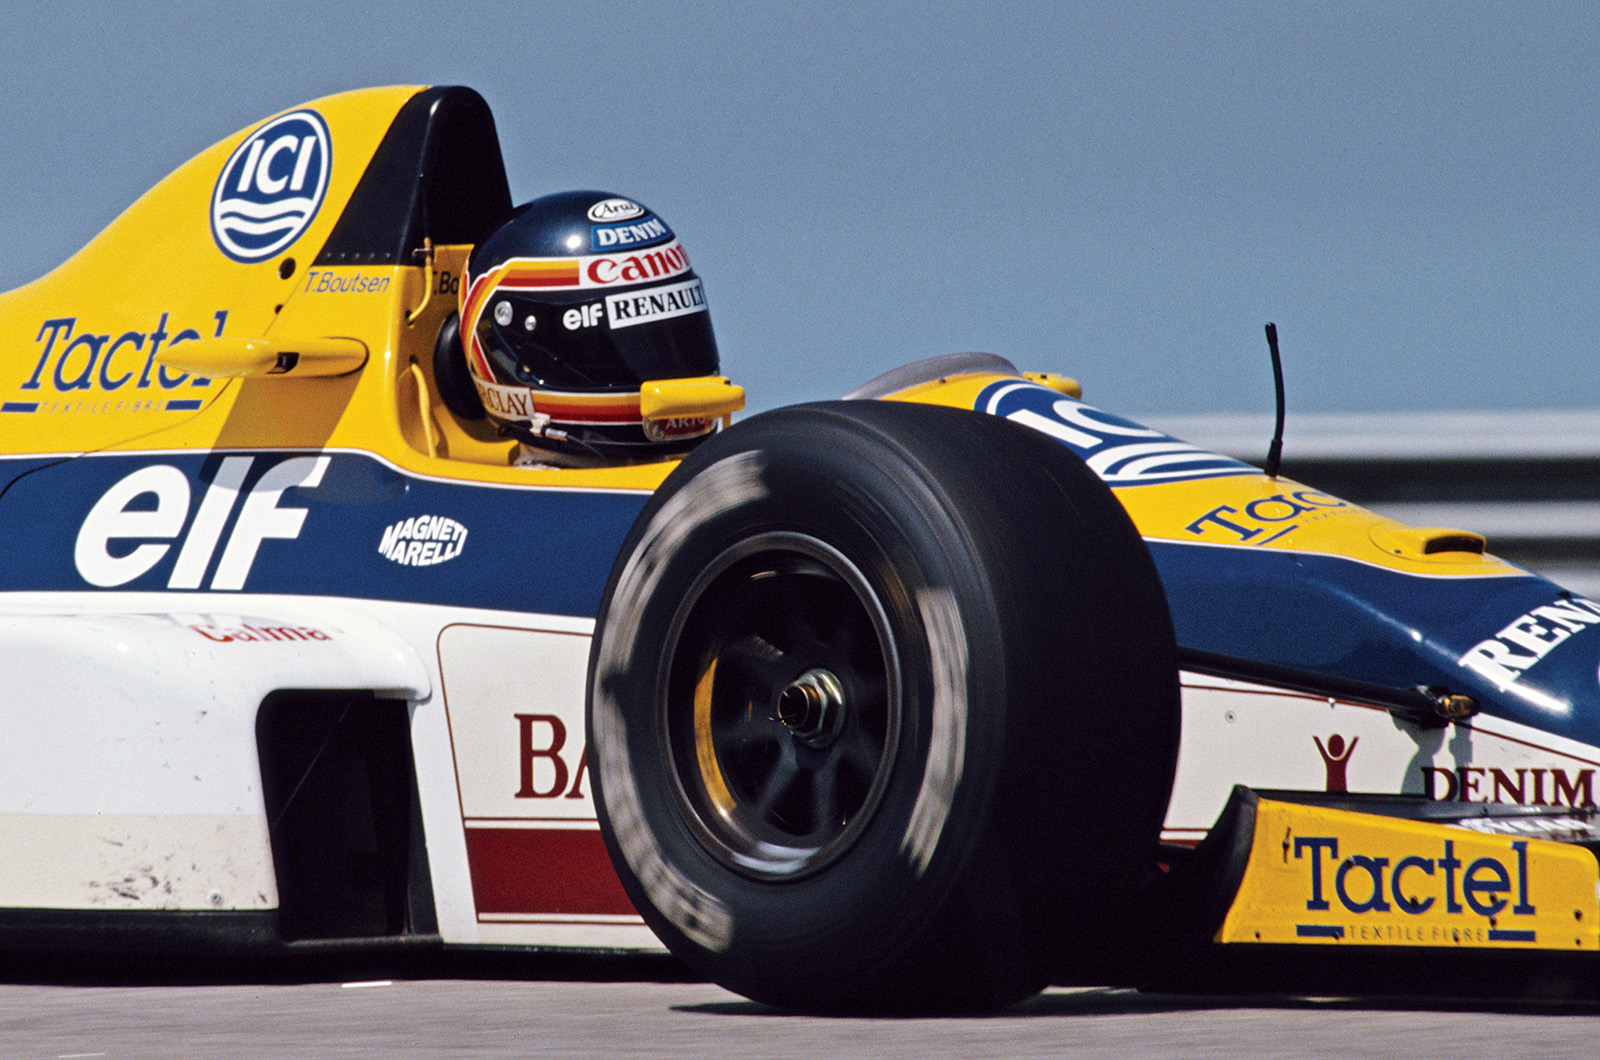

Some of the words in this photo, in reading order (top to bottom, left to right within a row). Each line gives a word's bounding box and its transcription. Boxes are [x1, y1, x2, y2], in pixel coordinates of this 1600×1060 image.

[237, 134, 317, 194] ICI
[596, 218, 667, 247] DENIM
[304, 271, 391, 294] T.Boutsen
[562, 302, 604, 331] elf
[612, 284, 705, 321] RENAULT
[41, 401, 109, 415] TEXTILE
[114, 400, 165, 414] FIBRE
[74, 456, 332, 591] elf
[1421, 766, 1597, 807] DENIM
[1293, 836, 1537, 917] Tactel
[1349, 925, 1426, 941] TEXTILE
[1431, 926, 1485, 942] FIBRE
